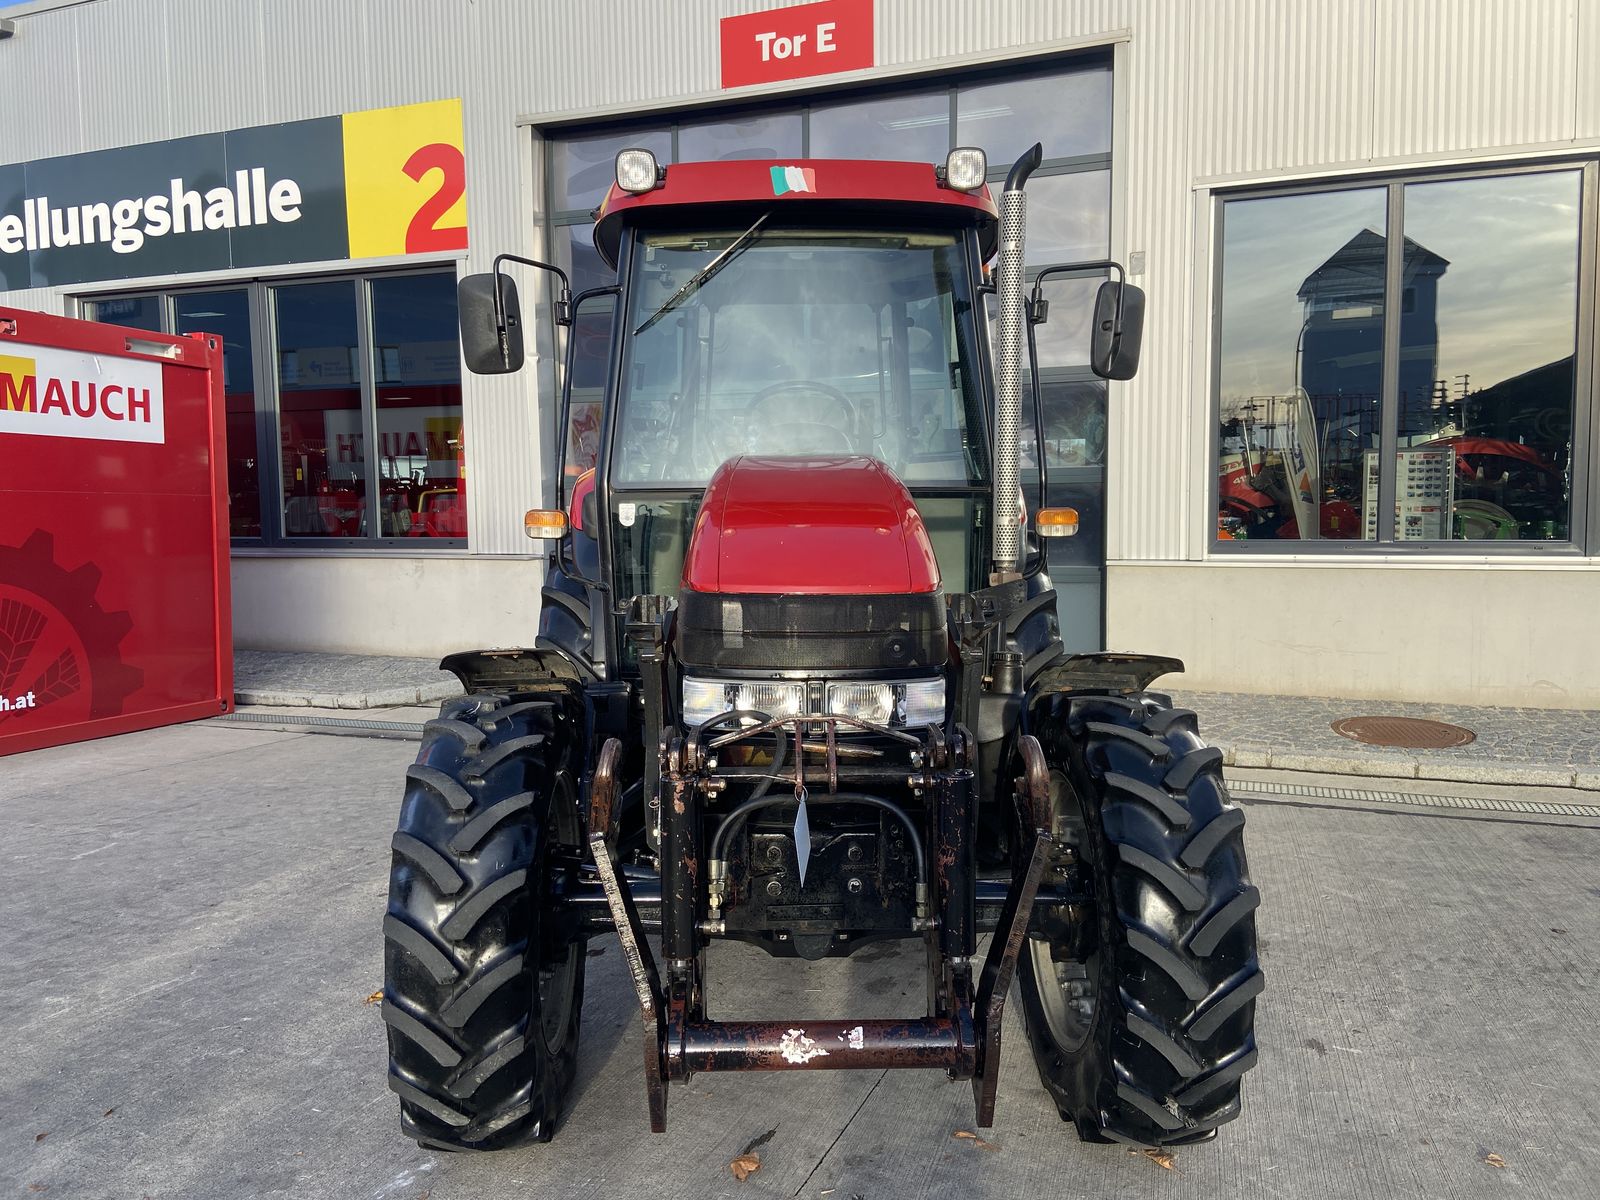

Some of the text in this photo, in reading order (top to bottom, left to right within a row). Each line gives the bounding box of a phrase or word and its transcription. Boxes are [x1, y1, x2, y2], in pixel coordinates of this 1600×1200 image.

[755, 22, 836, 62] Tor E
[0, 142, 468, 254] ellungshalle 2
[0, 372, 151, 423] MAUCH
[0, 691, 35, 711] h.at
